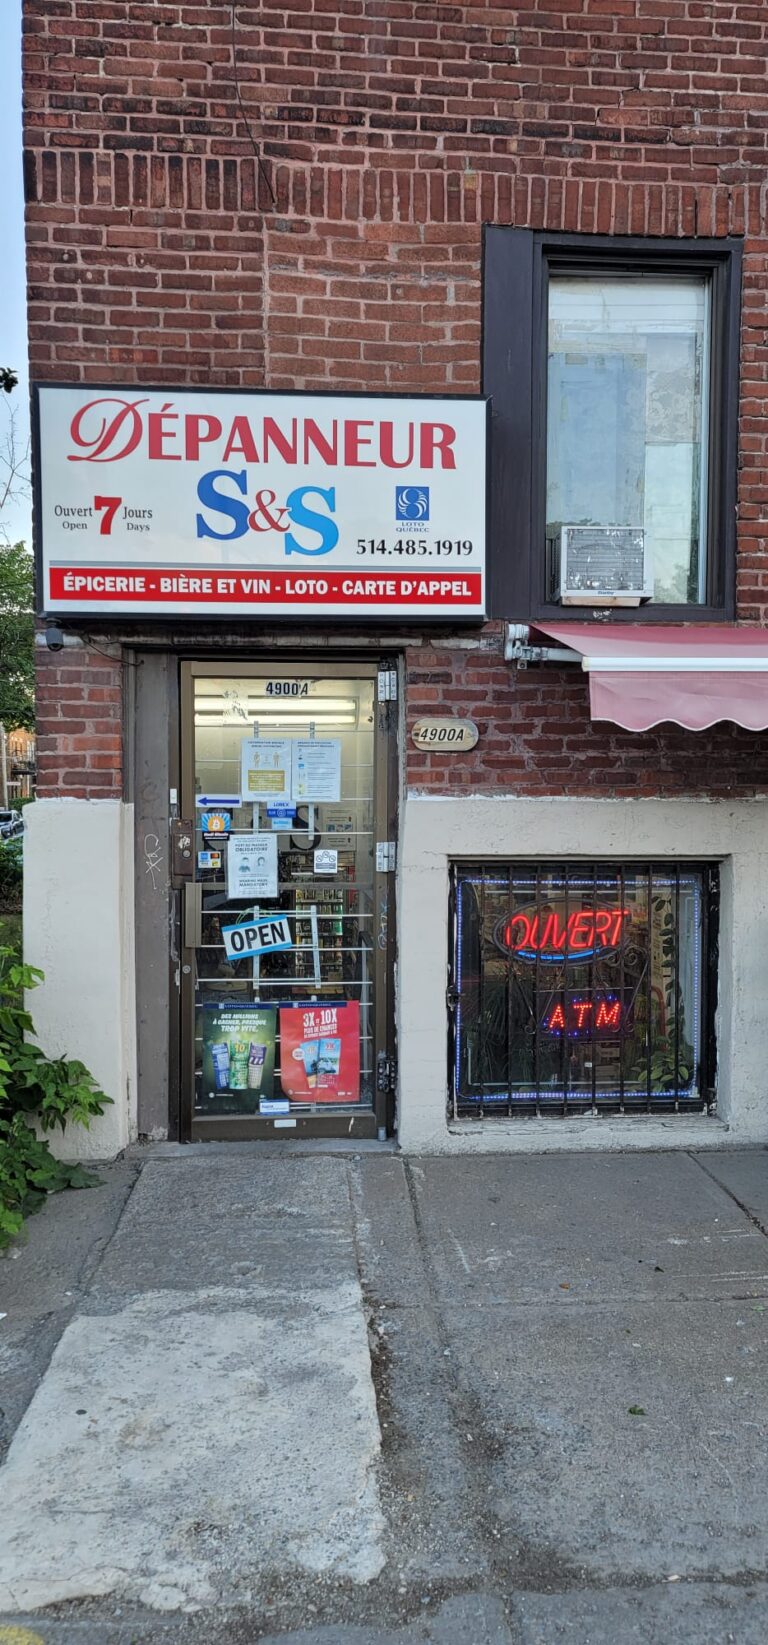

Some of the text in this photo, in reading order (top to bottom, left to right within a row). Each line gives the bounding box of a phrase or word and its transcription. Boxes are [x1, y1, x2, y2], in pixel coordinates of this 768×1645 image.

[66, 398, 457, 470] DÉPANNEUR
[54, 495, 153, 535] Ouvert 7 Jours
[196, 469, 339, 556] S&S
[62, 521, 150, 531] Open Days
[356, 538, 473, 556] 514.485.1919
[63, 571, 146, 592] ÉPICERIE
[160, 573, 213, 594] BIÈRE
[217, 577, 237, 594] ET
[240, 578, 270, 594] VIN
[285, 579, 328, 595] LOTO
[342, 579, 396, 596] CARTE
[400, 580, 472, 596] D'APPEL
[266, 682, 309, 696] 4900A
[420, 727, 464, 741] 4900A
[230, 921, 287, 952] OPEN
[505, 910, 630, 950] OUVERT
[303, 1012, 315, 1027] 3X
[320, 1008, 337, 1025] 10X
[549, 1003, 621, 1028] ATM
